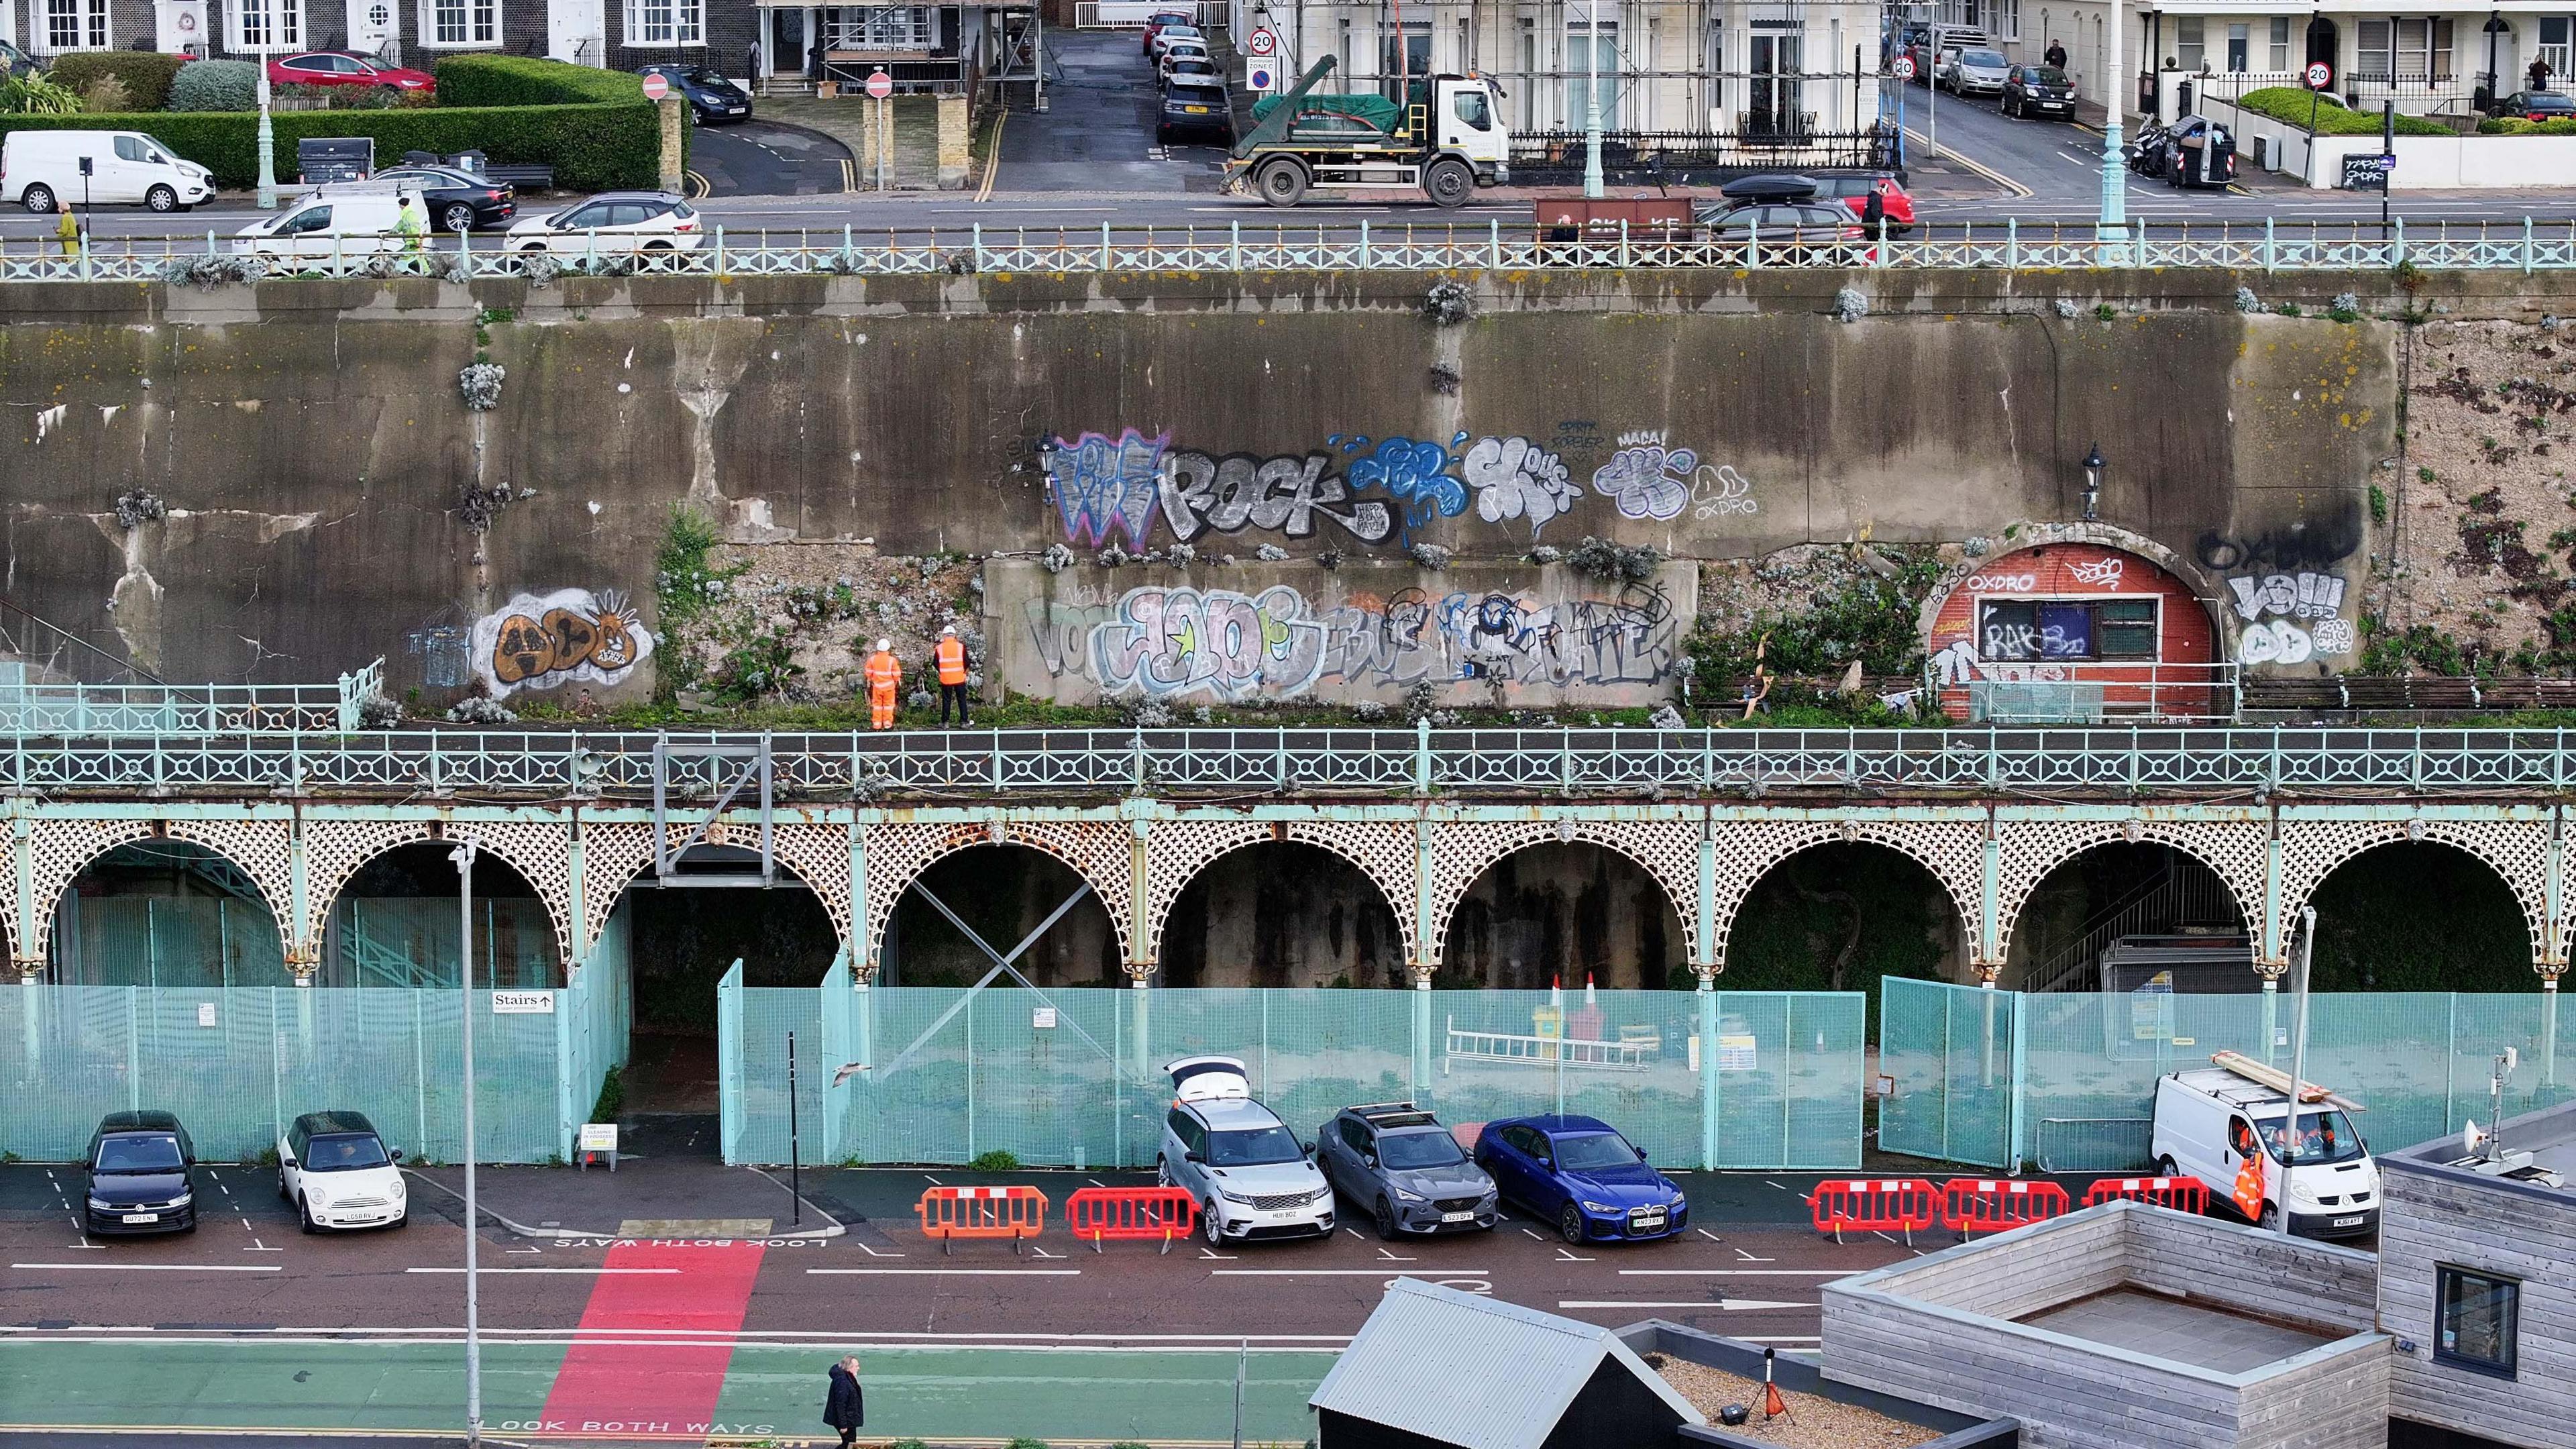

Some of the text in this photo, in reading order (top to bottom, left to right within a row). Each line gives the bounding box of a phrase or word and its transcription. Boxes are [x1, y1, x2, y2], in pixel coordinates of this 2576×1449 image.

[1254, 36, 1271, 47] 20
[1896, 62, 1912, 73] 20
[2310, 69, 2326, 80] 20
[1155, 452, 1389, 545] ROCK
[1967, 574, 2035, 592] OXDRO
[495, 994, 537, 1005] Stairs
[553, 1238, 826, 1248] LOOK BOTH WAYS
[478, 1419, 776, 1435] LOOK BOTH WAYS
